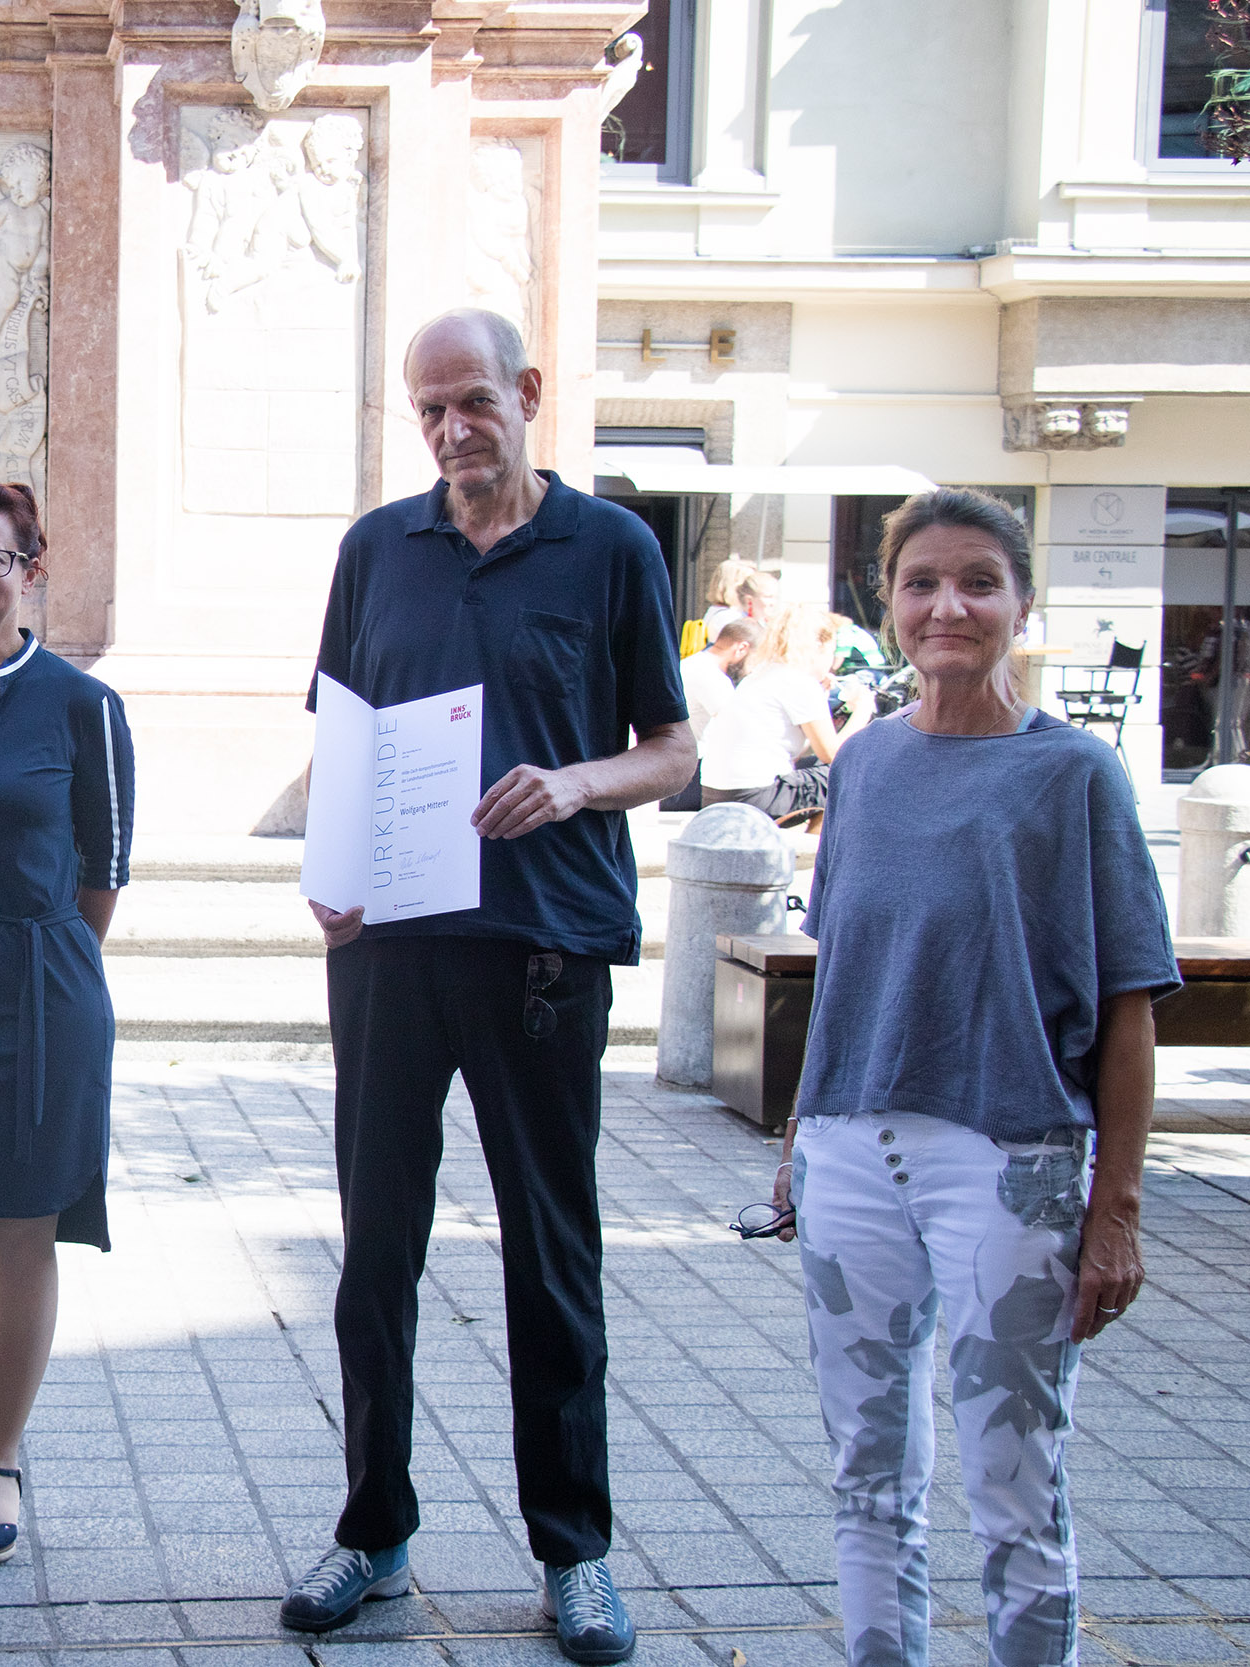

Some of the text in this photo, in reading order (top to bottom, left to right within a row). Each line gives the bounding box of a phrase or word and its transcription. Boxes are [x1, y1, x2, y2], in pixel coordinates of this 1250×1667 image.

[1073, 550, 1137, 564] BAR CENTRALE
[450, 710, 472, 723] BRUCK
[373, 718, 398, 889] URKUNDE
[400, 799, 449, 816] Wolfgang Mitterer
